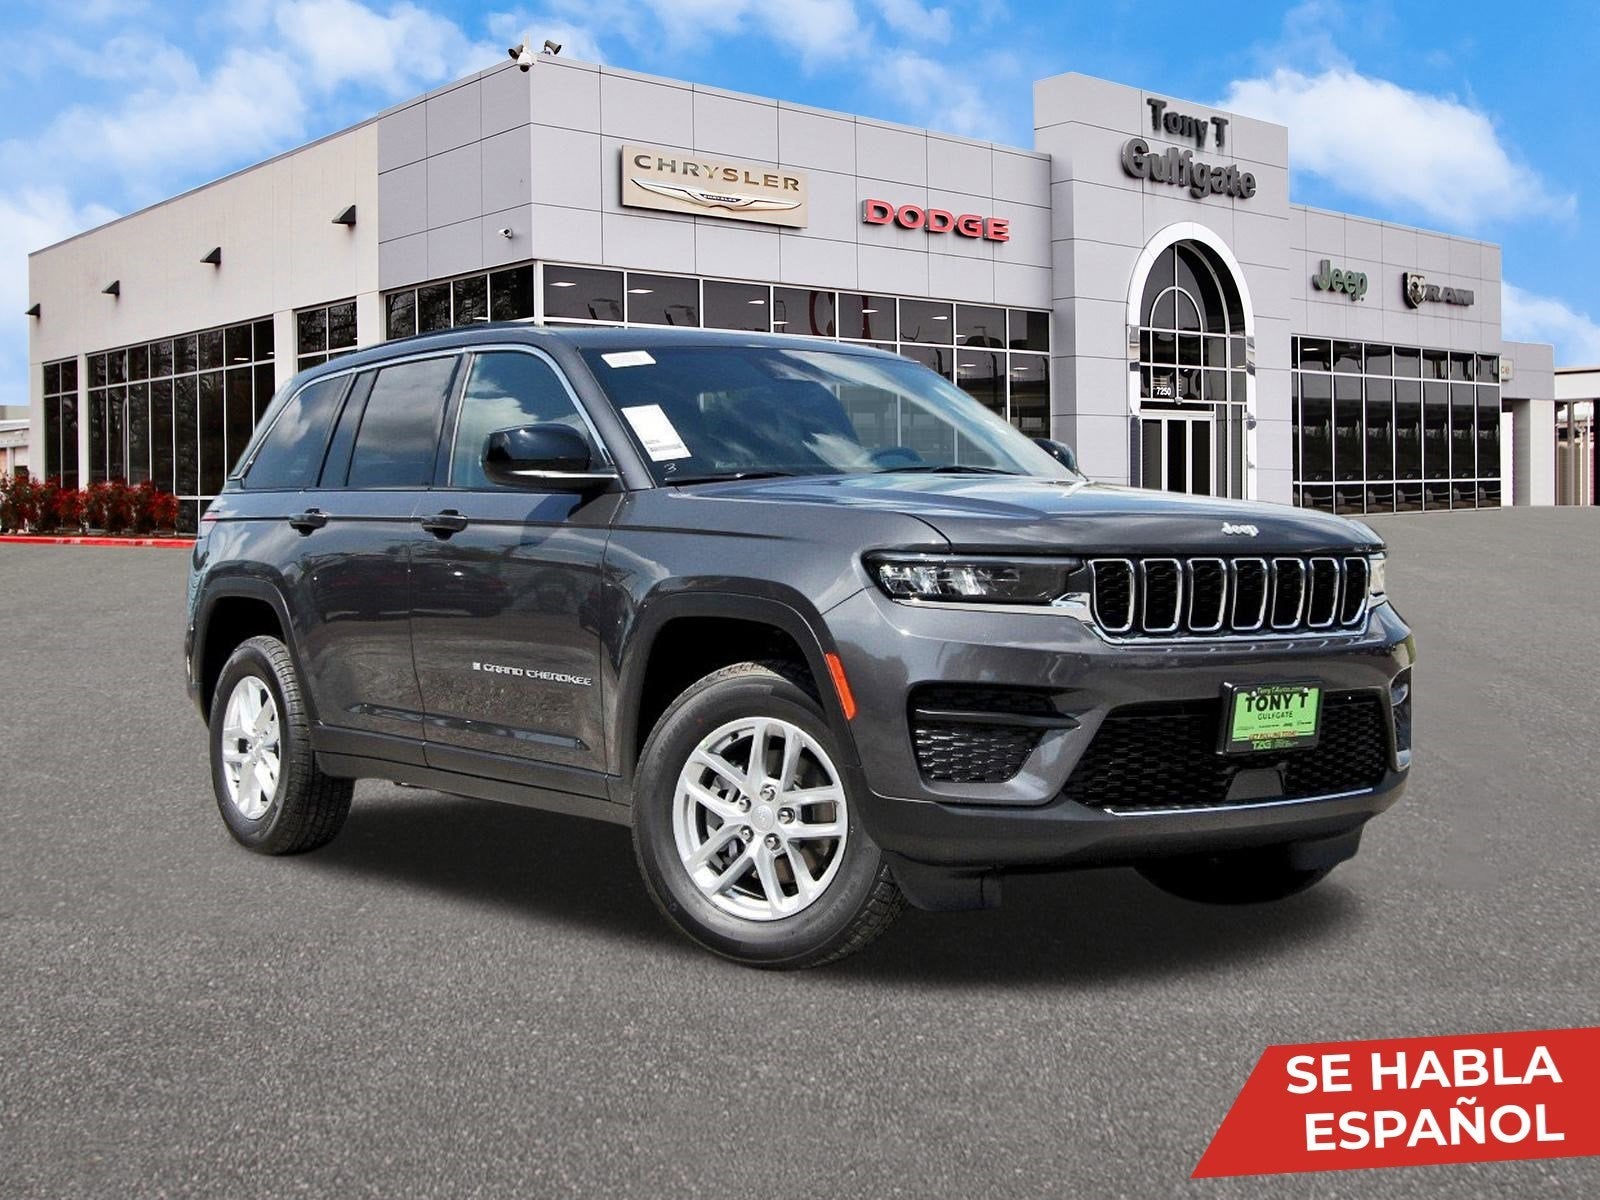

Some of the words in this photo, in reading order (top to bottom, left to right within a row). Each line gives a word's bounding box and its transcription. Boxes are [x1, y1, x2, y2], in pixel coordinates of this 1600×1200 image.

[1147, 98, 1209, 148] Tony
[1210, 116, 1229, 147] T
[633, 153, 801, 192] CHRYSLER
[1121, 138, 1257, 199] Gulfgate
[862, 198, 1011, 242] DODGE
[1312, 259, 1368, 301] Jeep
[1425, 283, 1474, 306] RAM
[1156, 386, 1172, 396] 7250
[1221, 521, 1260, 537] Jeep
[483, 663, 524, 677] GRAND
[526, 669, 592, 687] CHEROKEE
[1246, 692, 1294, 712] TONY
[1299, 692, 1309, 708] T
[1257, 711, 1293, 720] GULFGATE
